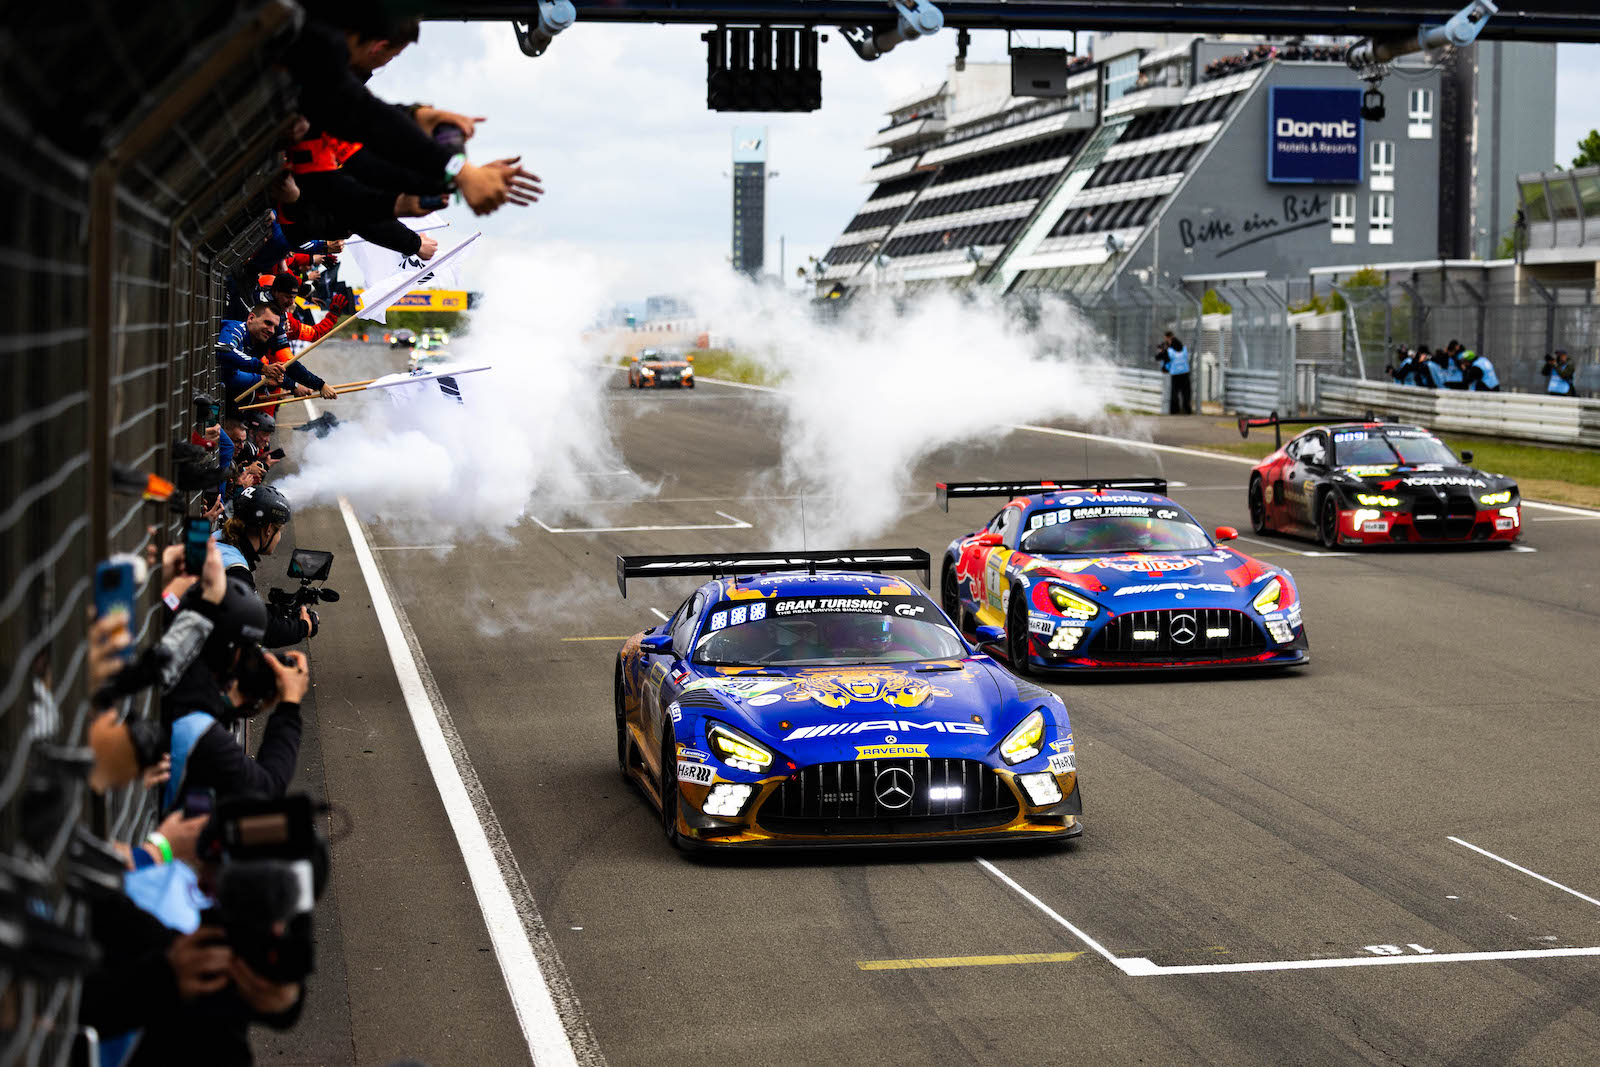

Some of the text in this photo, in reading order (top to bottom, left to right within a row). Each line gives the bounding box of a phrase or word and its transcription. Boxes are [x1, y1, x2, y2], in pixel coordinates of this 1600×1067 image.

[1276, 118, 1357, 138] Dorint
[1277, 142, 1357, 153] Hotels & Resorts
[1178, 193, 1328, 248] Bitte ein Bit
[1403, 477, 1487, 488] YOKOHAMA
[1086, 495, 1148, 503] viaplay
[1073, 506, 1149, 517] GRAN TURISMO
[775, 600, 816, 612] GRAN
[850, 720, 989, 735] AMG
[863, 747, 922, 755] RAVENOL
